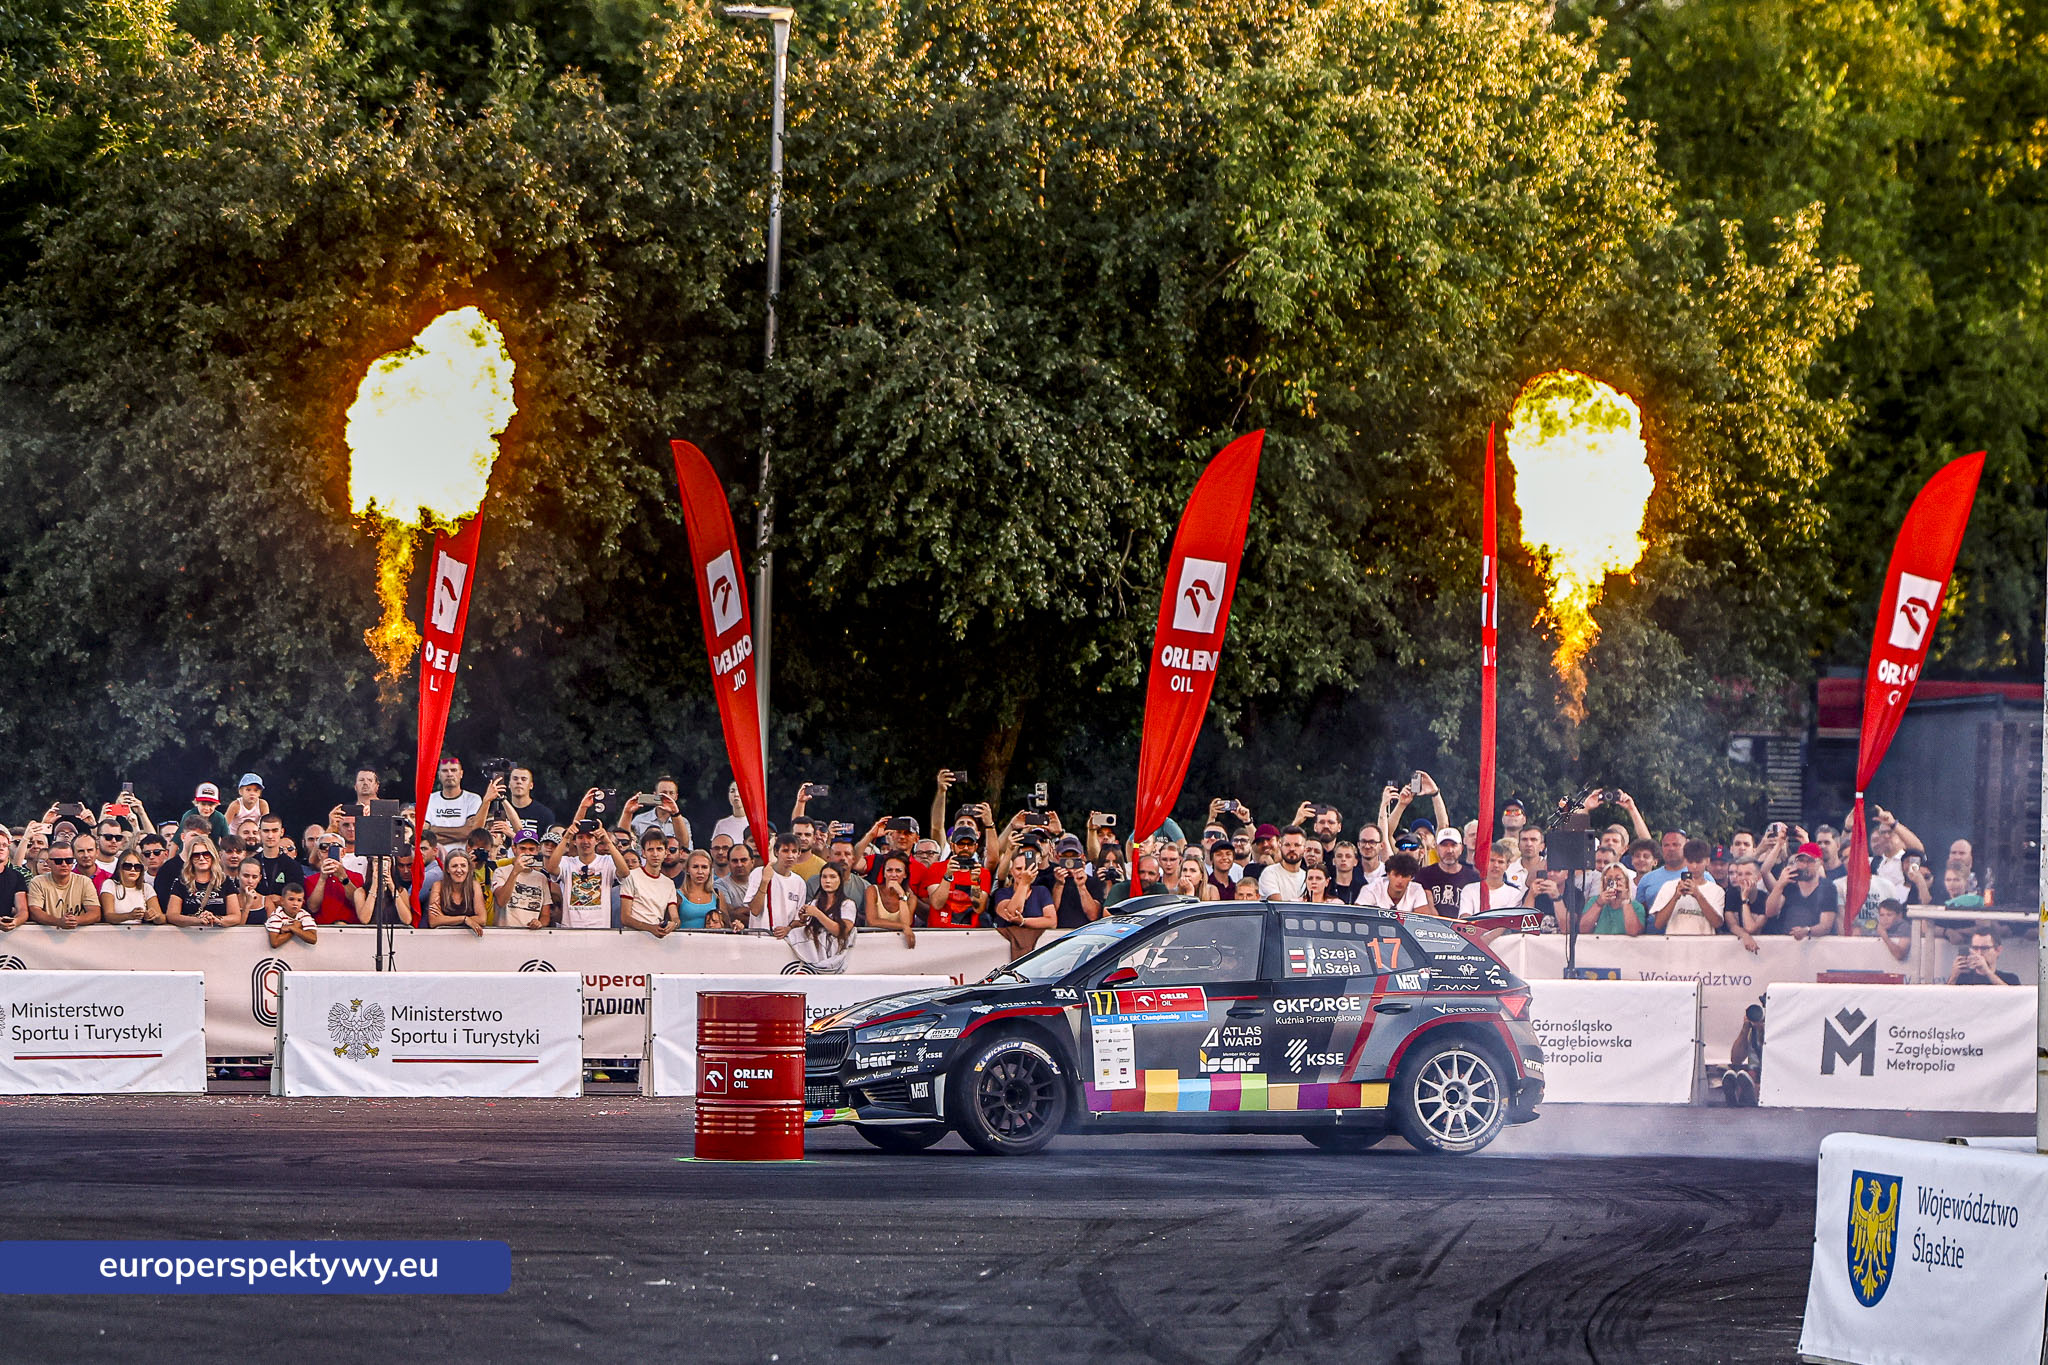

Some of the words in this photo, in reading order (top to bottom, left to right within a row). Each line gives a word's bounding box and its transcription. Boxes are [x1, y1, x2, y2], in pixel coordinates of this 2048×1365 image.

[1161, 644, 1219, 671] ORLEN
[1170, 674, 1194, 693] OIL
[1432, 884, 1462, 908] GA
[1308, 947, 1357, 962] J.Szeja
[1367, 937, 1403, 969] 17
[1446, 954, 1486, 962] MEGA-PRESS
[1310, 961, 1361, 976] M.Szeja
[582, 974, 646, 992] upera
[1091, 991, 1113, 1015] 17
[1159, 992, 1189, 1000] ORLEN
[11, 1002, 125, 1019] Ministerstwo
[1272, 996, 1362, 1014] GKFORGE
[391, 1005, 503, 1022] Ministerstwo
[1275, 1016, 1304, 1025] Kuźnia
[1306, 1014, 1362, 1024] Przemysłowa
[11, 1025, 69, 1044] Sportu
[74, 1024, 79, 1040] i
[84, 1022, 162, 1043] Turystyki
[1222, 1026, 1262, 1036] ATLAS
[1532, 1019, 1613, 1034] Górnośląsko
[1888, 1025, 1966, 1043] Górnośląsko
[390, 1028, 447, 1047] Sportu
[453, 1028, 457, 1044] i
[462, 1028, 540, 1048] Turystyki
[1222, 1036, 1262, 1047] WARD
[1887, 1042, 1984, 1058] -Zagłębiowska
[1306, 1052, 1345, 1066] KSSE
[1543, 1051, 1603, 1066] etropolia
[1886, 1058, 1955, 1074] Metropolia
[733, 1068, 774, 1079] ORLEN
[733, 1080, 749, 1089] OIL
[1916, 1185, 2019, 1229] Województwo
[1911, 1226, 1966, 1273] Śląskie
